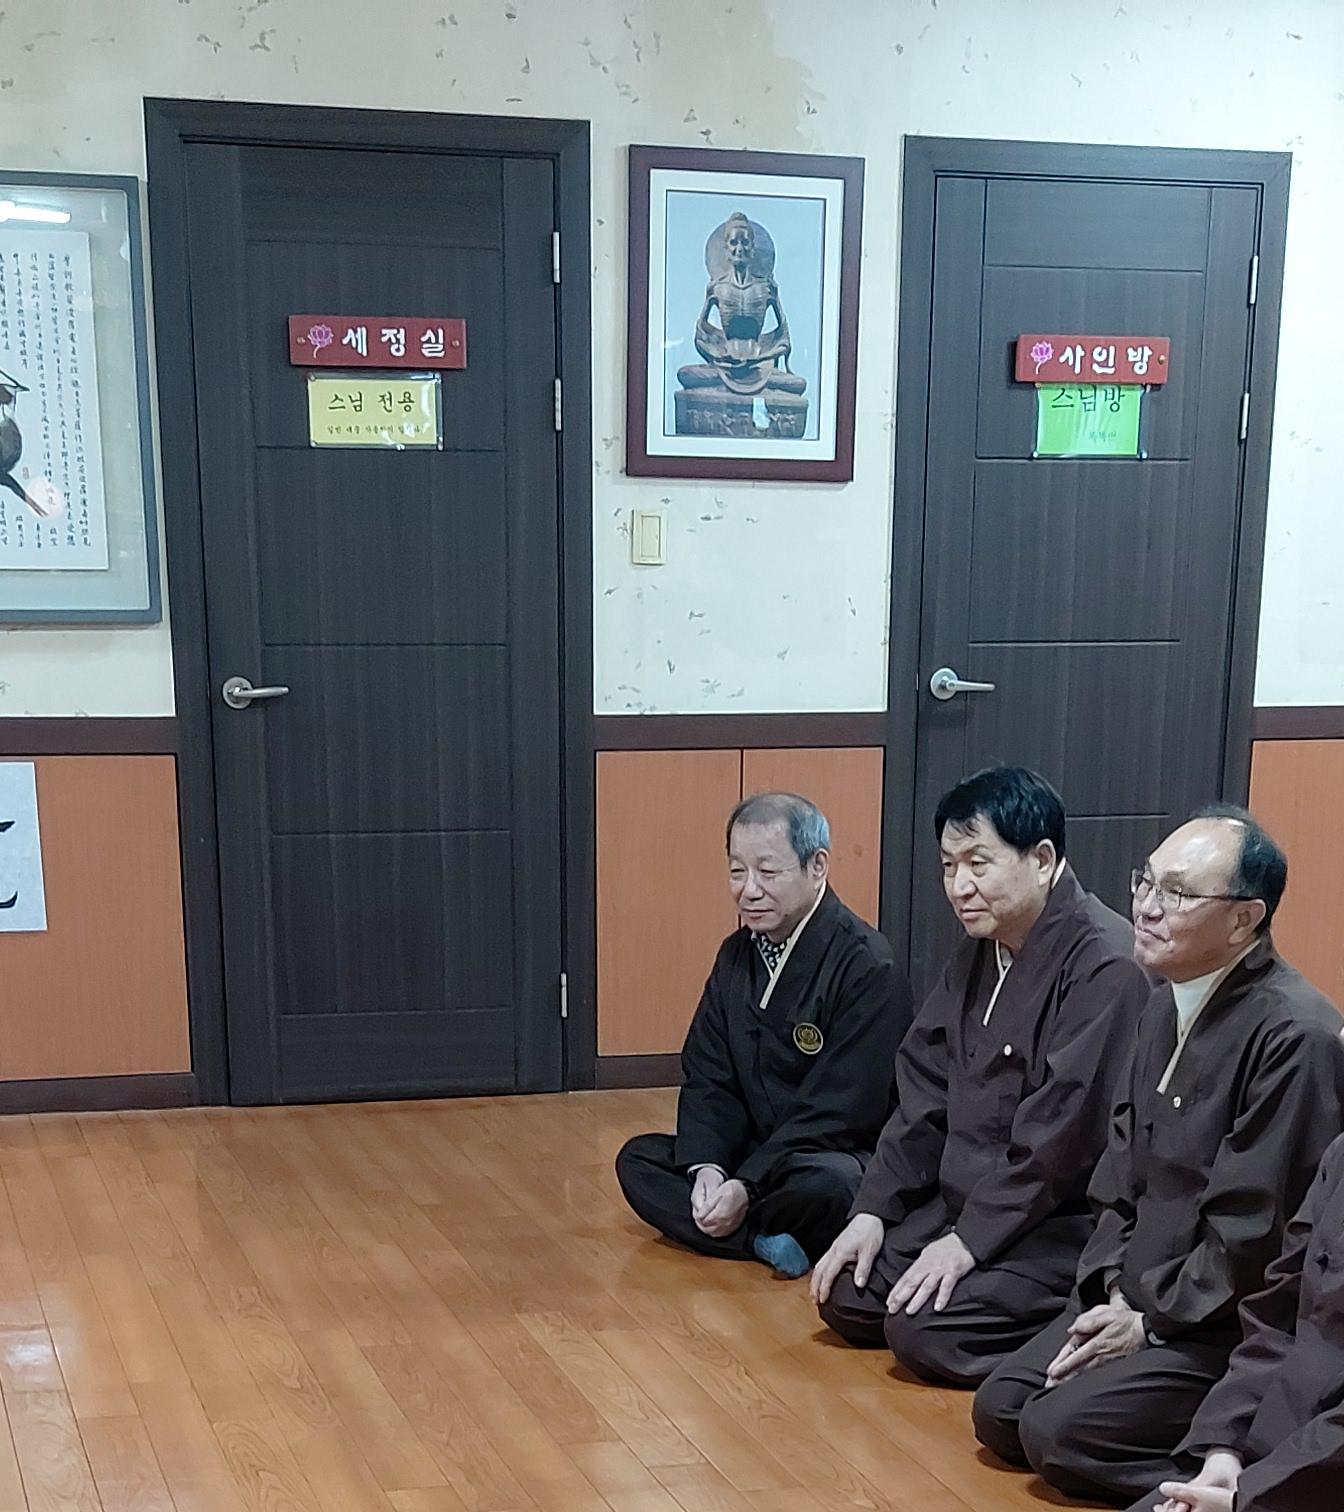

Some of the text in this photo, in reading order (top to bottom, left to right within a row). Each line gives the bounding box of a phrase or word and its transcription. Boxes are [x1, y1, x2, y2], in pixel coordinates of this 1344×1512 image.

[341, 326, 446, 358] 세정실
[328, 391, 416, 413] 스님 전용
